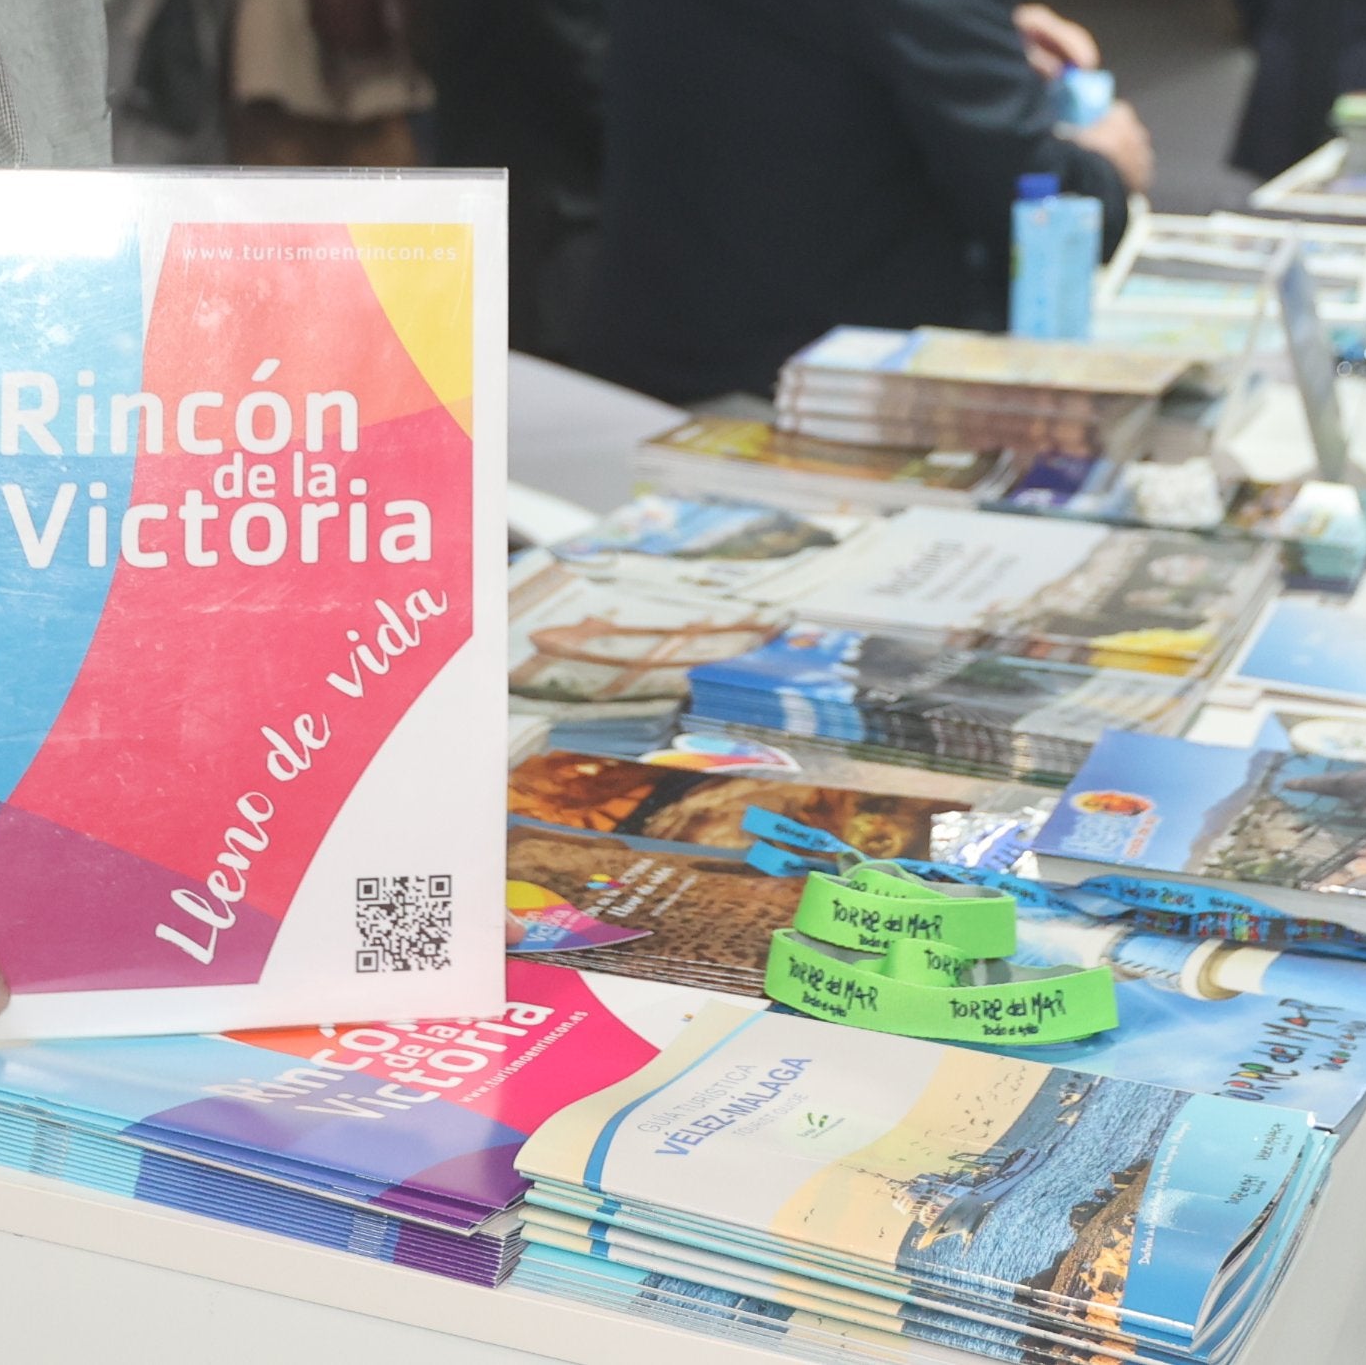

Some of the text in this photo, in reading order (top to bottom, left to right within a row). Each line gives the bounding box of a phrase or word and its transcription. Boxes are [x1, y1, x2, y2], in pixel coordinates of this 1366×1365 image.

[183, 244, 458, 262] www.turismoenrincon.es
[0, 358, 360, 456] Rincón
[213, 451, 337, 499] de la
[2, 478, 432, 569] Victoria
[155, 588, 448, 965] Lleno de vida
[832, 898, 944, 940] TORRE del MAR
[844, 979, 879, 1012] MAR
[949, 989, 1067, 1024] TORRE del MAR
[295, 1001, 555, 1120] Victoria
[380, 1024, 461, 1068] de la
[654, 1058, 813, 1156] VÉLEZ-MÁLAGA
